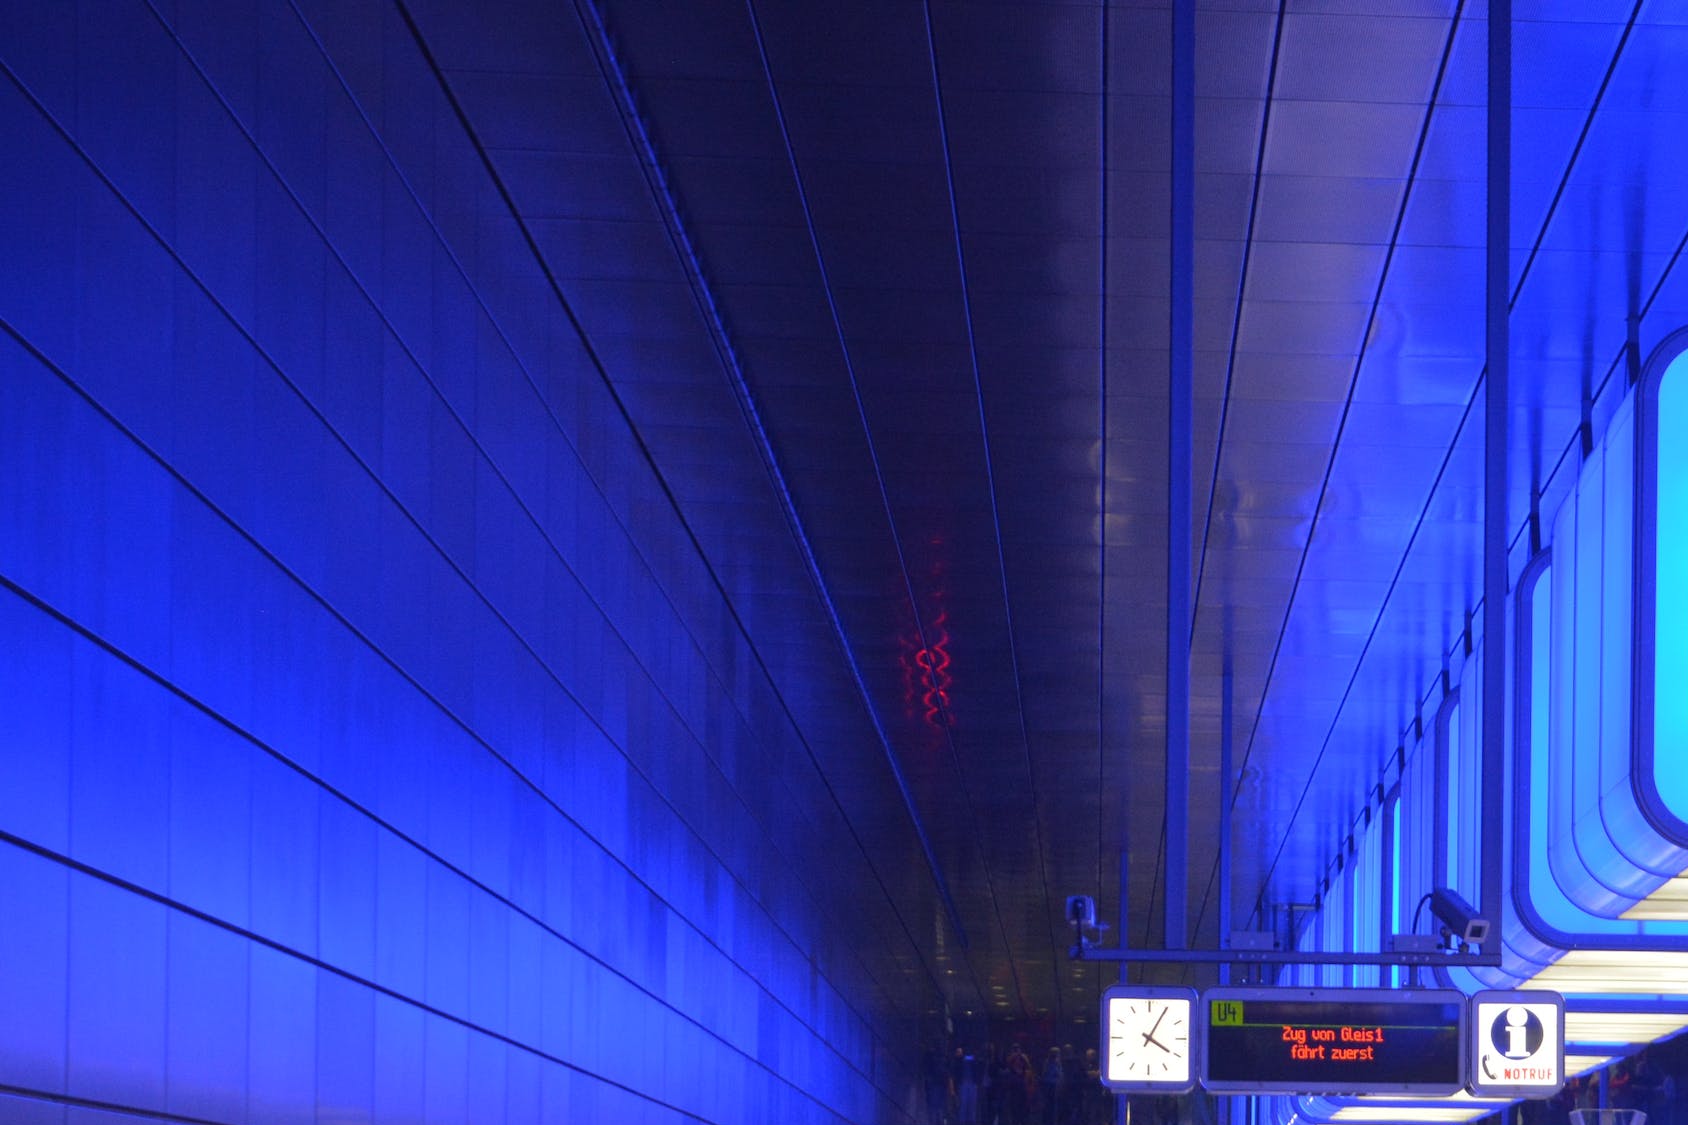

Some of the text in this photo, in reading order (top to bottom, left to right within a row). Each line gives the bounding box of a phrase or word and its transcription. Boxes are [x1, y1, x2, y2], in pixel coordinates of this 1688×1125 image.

[1217, 1004, 1237, 1023] U4
[1282, 1026, 1307, 1043] Zug
[1312, 1029, 1335, 1041] von
[1291, 1045, 1374, 1060] fährt zuerst
[1504, 1068, 1552, 1080] NOTRUF
